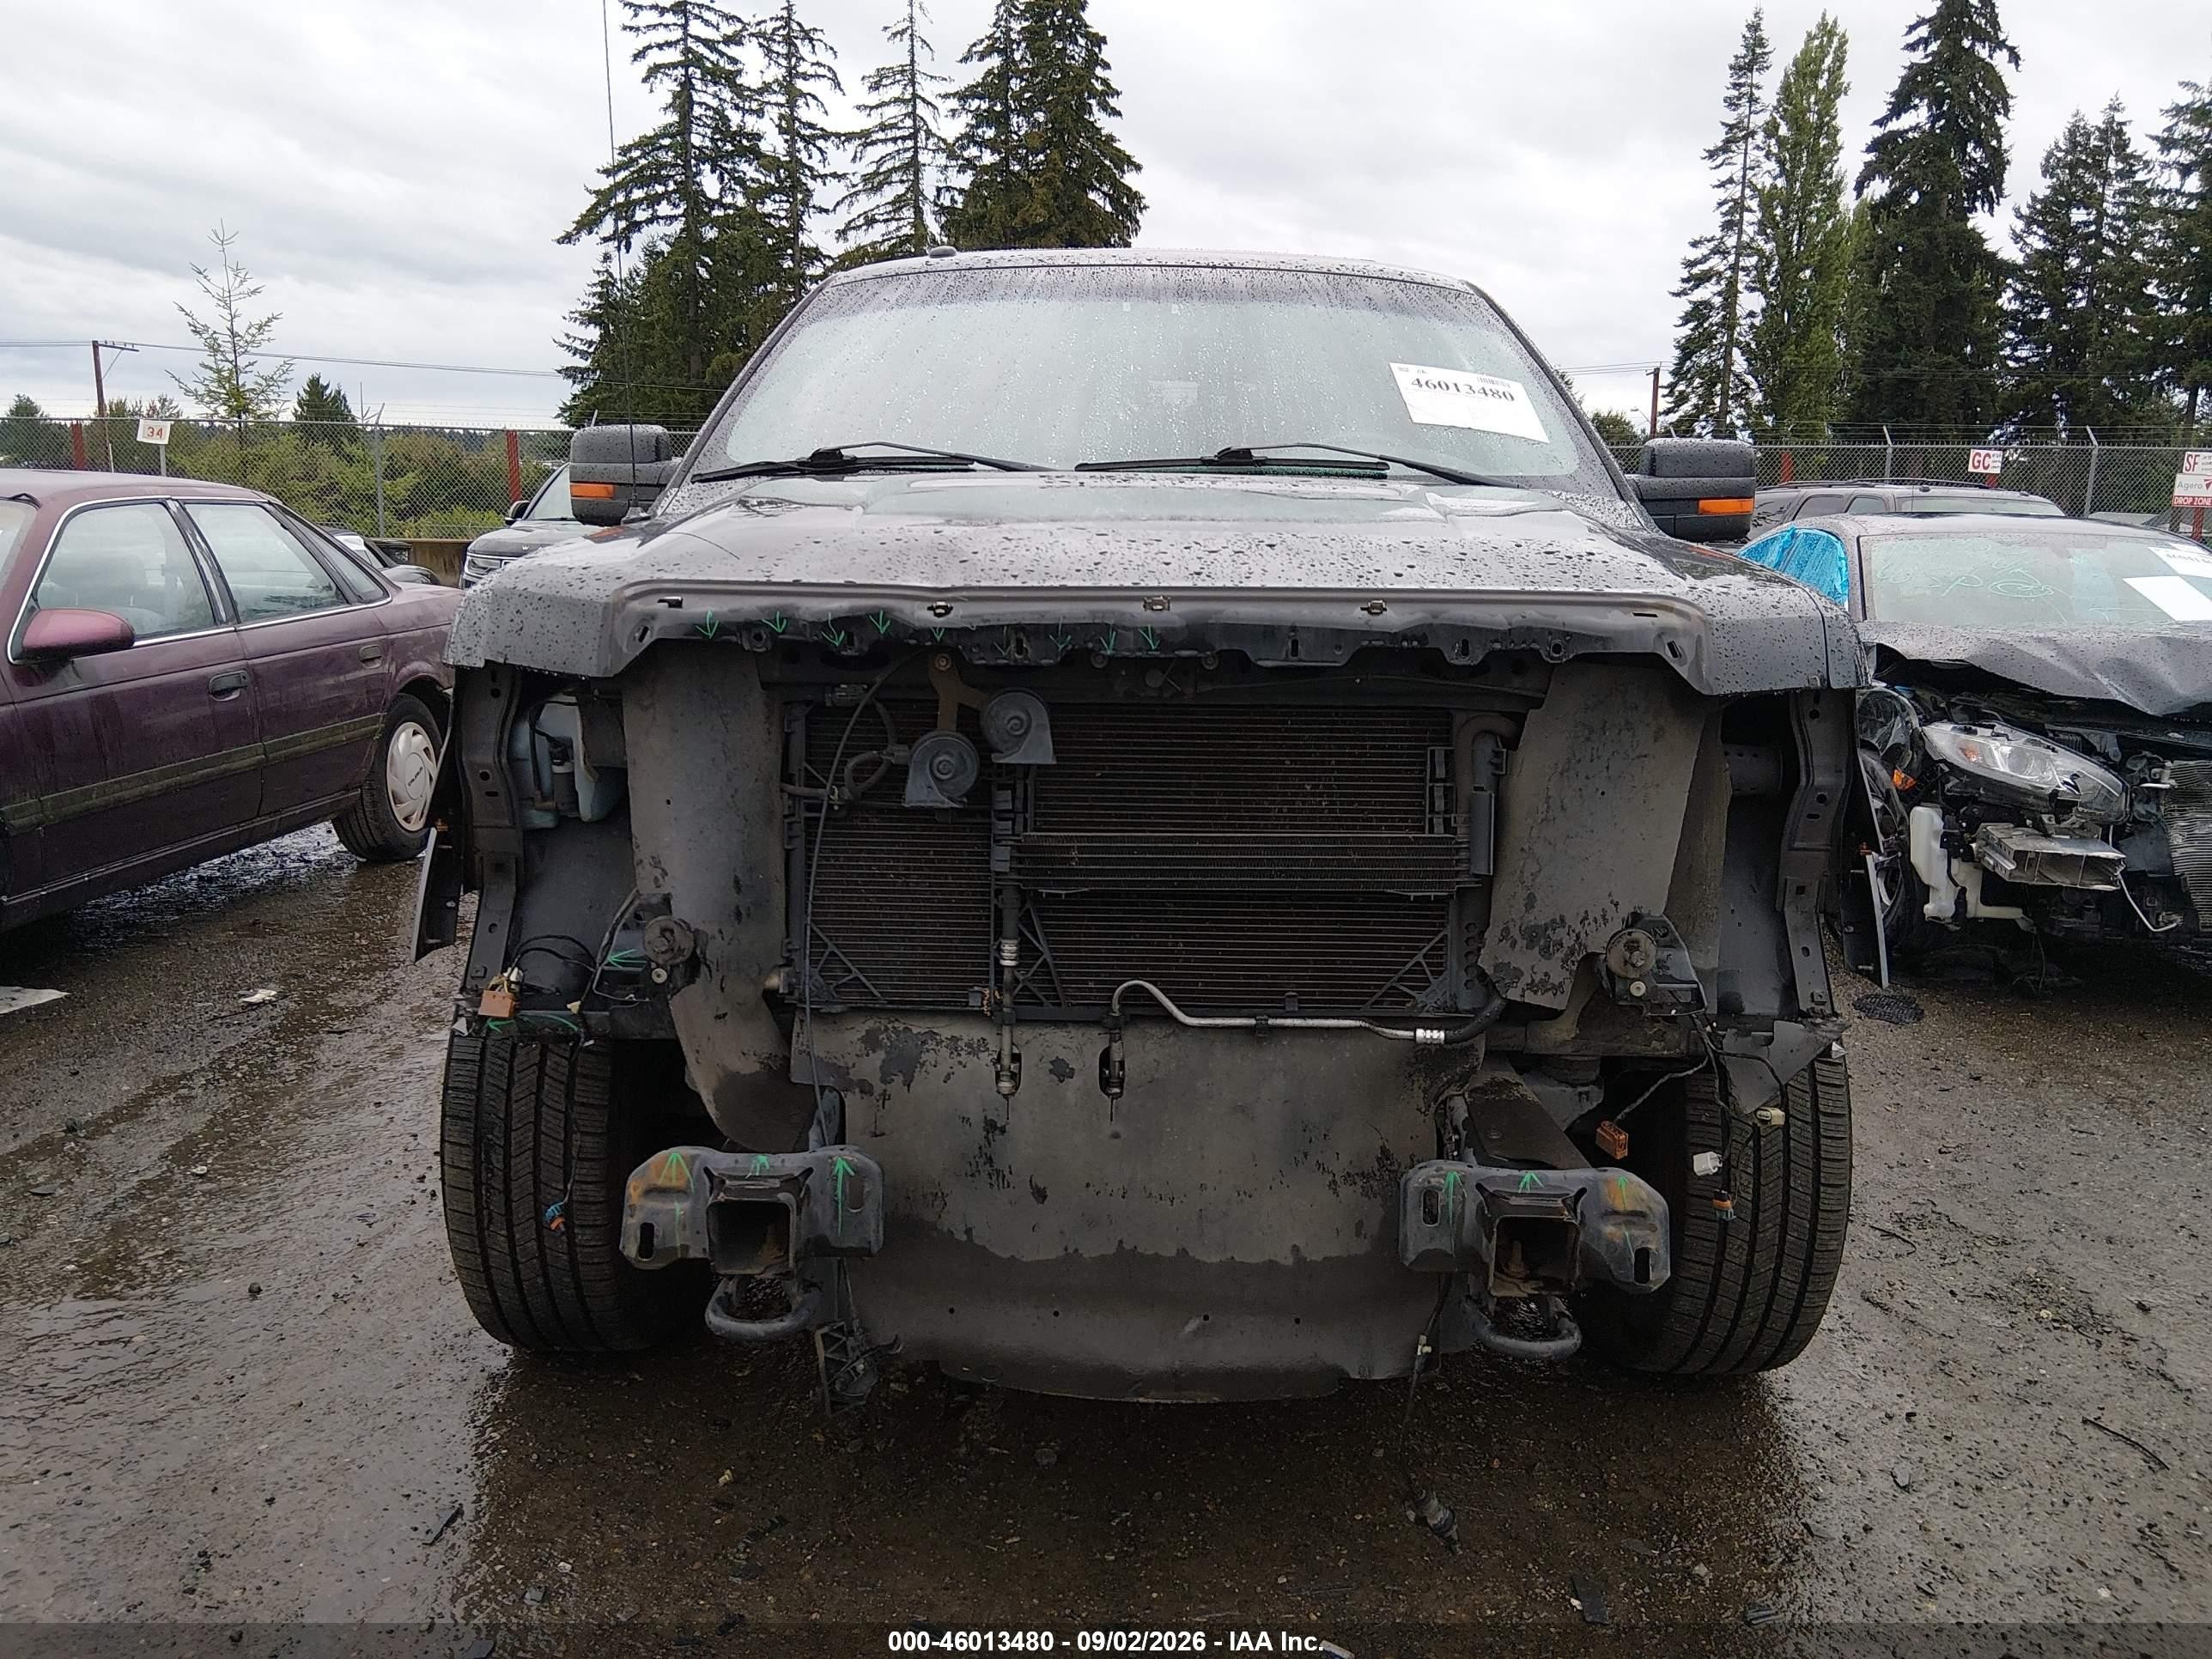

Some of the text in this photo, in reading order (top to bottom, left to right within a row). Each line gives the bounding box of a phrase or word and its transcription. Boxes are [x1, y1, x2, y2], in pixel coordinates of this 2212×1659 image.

[1411, 378, 1515, 401] 46013480
[147, 426, 163, 439] 34
[1972, 452, 1991, 471] GC
[2185, 453, 2201, 472] SF
[2177, 481, 2203, 490] Agero
[2174, 496, 2212, 506] DROP ZONE
